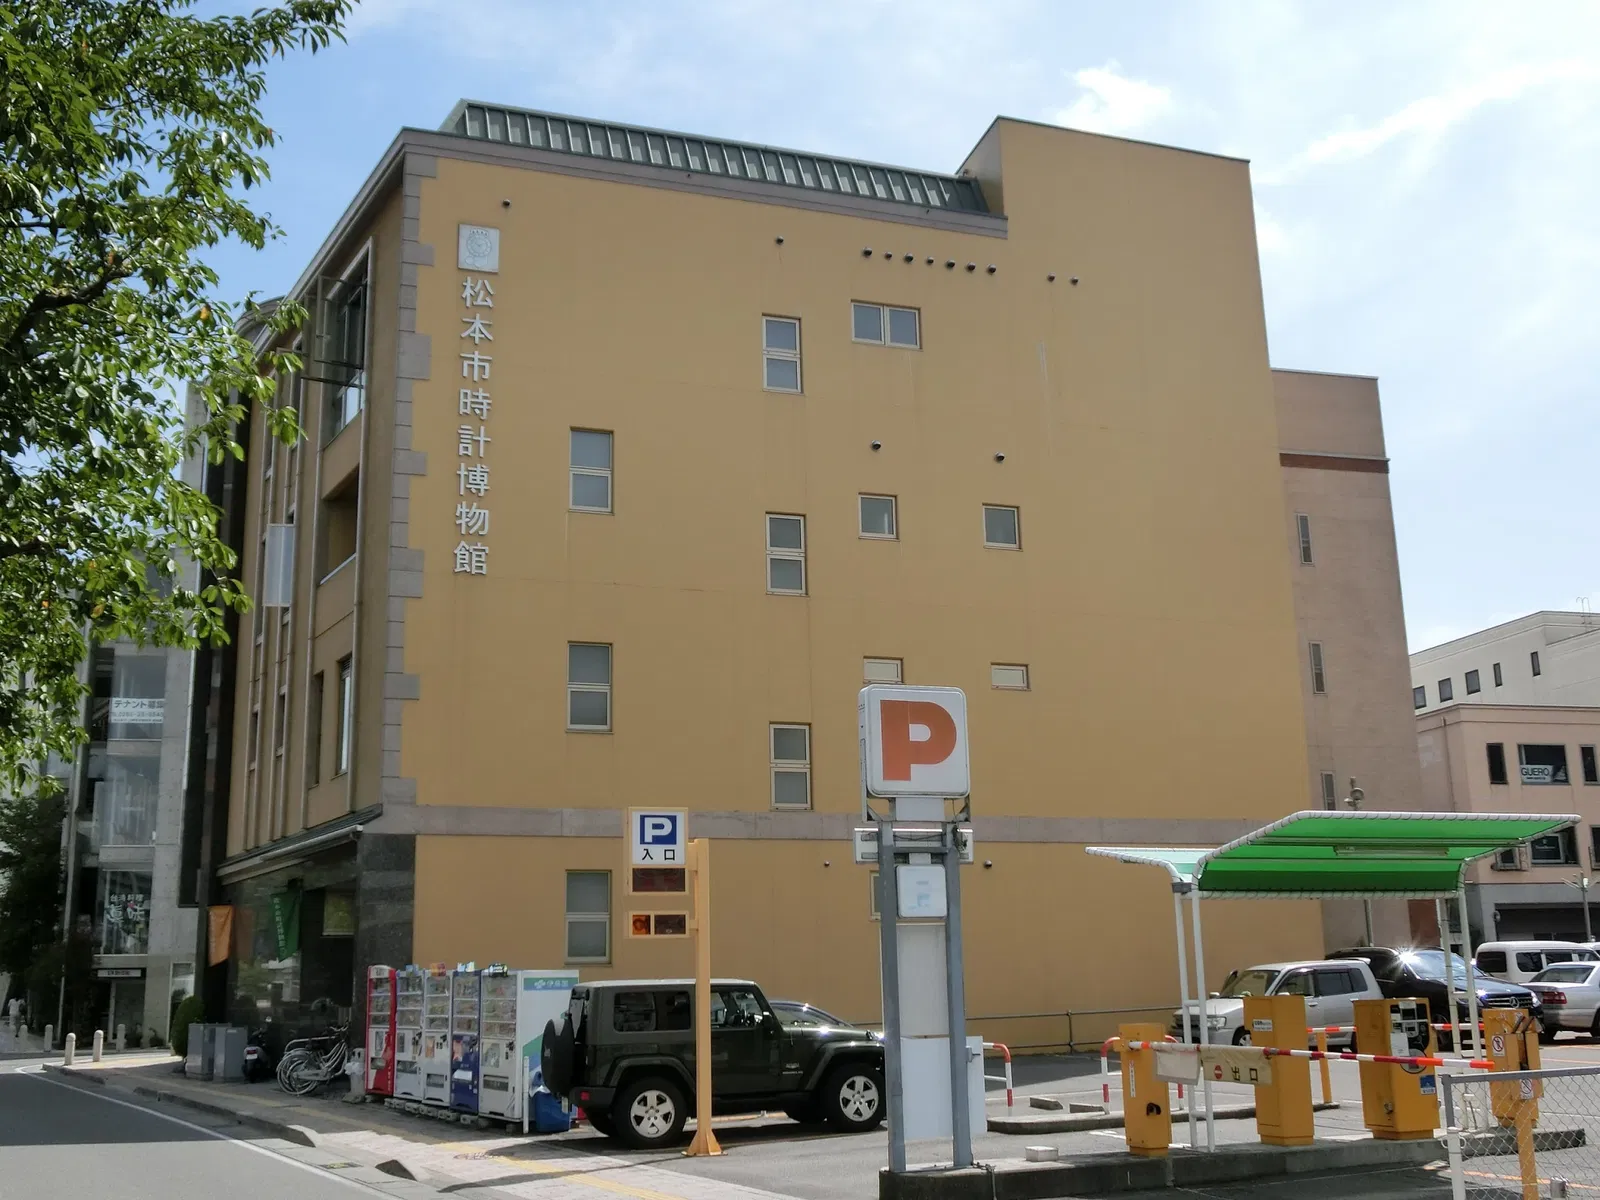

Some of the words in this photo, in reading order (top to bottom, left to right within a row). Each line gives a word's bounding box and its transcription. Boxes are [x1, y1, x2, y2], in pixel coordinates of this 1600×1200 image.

[454, 276, 494, 576] 松本市時計博物館
[880, 700, 957, 781] P
[644, 817, 672, 843] P
[641, 848, 676, 861] 入口
[1231, 1065, 1259, 1082] 出口
